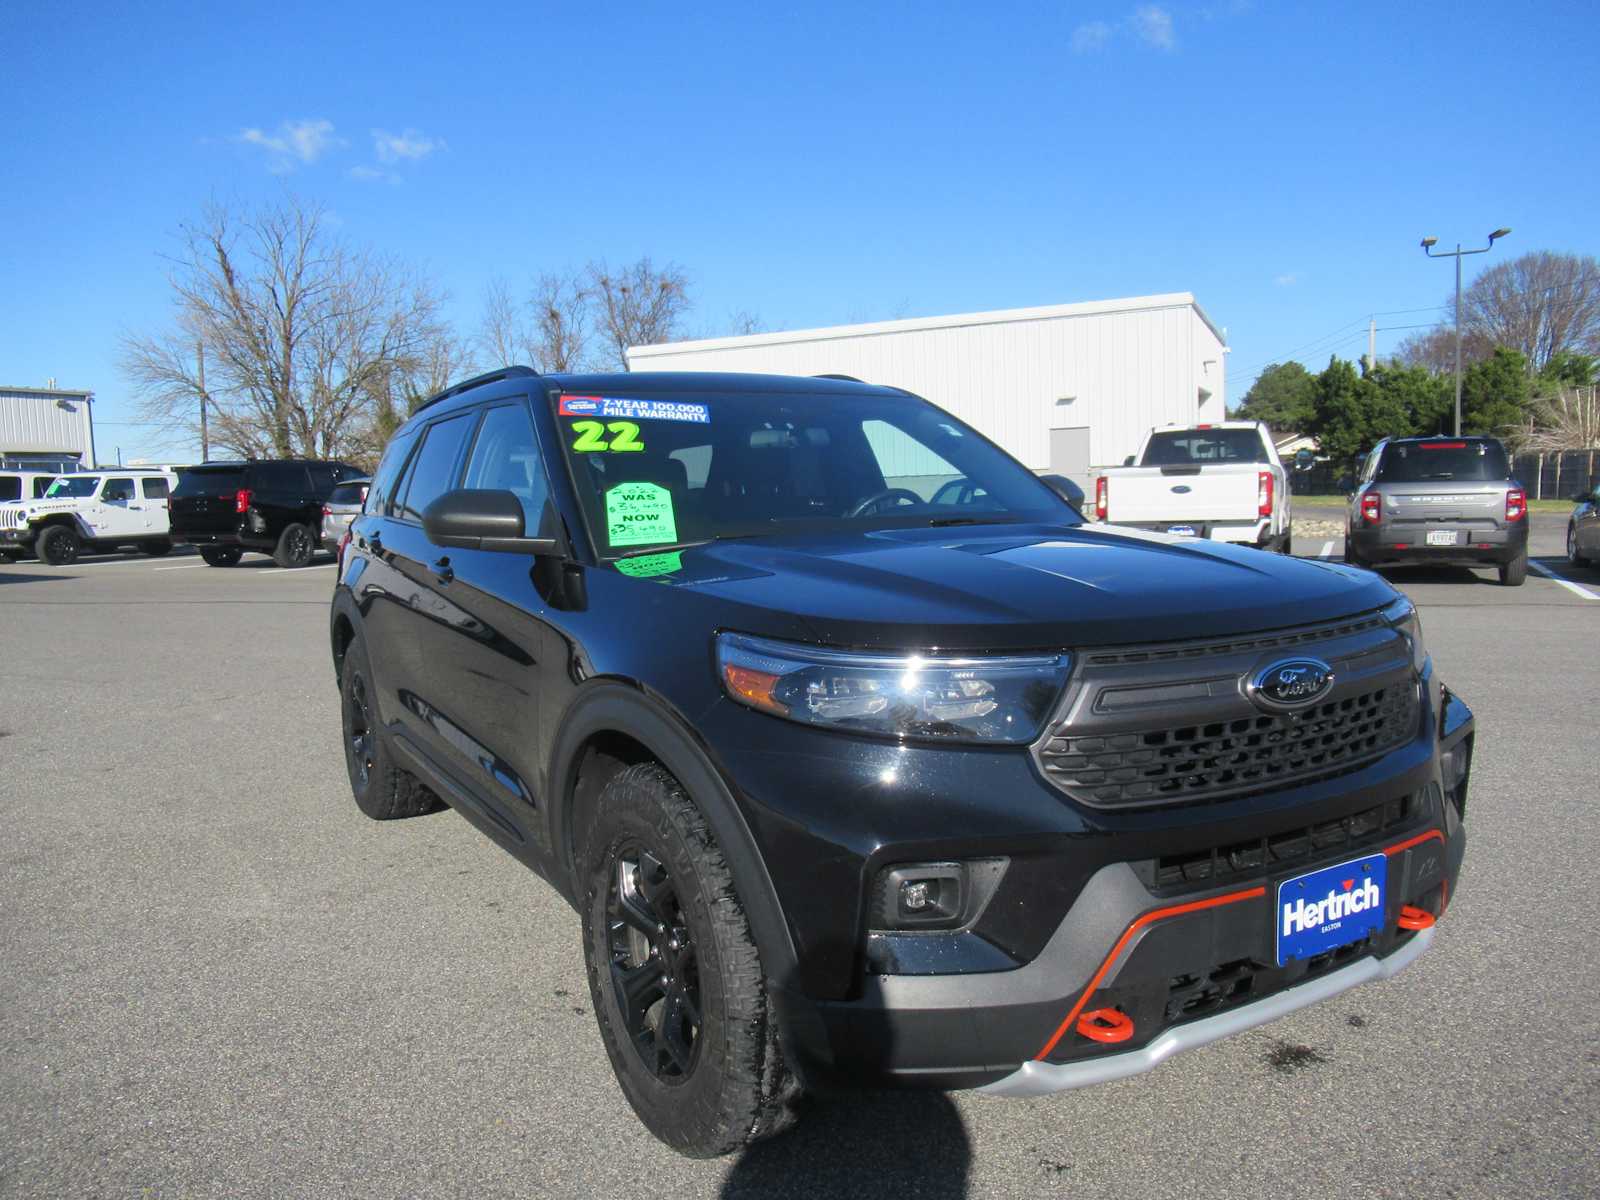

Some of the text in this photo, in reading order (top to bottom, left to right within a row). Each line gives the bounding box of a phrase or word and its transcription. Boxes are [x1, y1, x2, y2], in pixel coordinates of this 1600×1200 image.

[602, 399, 649, 410] 7-YEAR
[603, 407, 707, 421] MILE WARRANTY
[572, 420, 644, 452] 22
[622, 514, 660, 522] NOW
[1278, 668, 1323, 697] Ford
[1283, 877, 1380, 937] Hertrich
